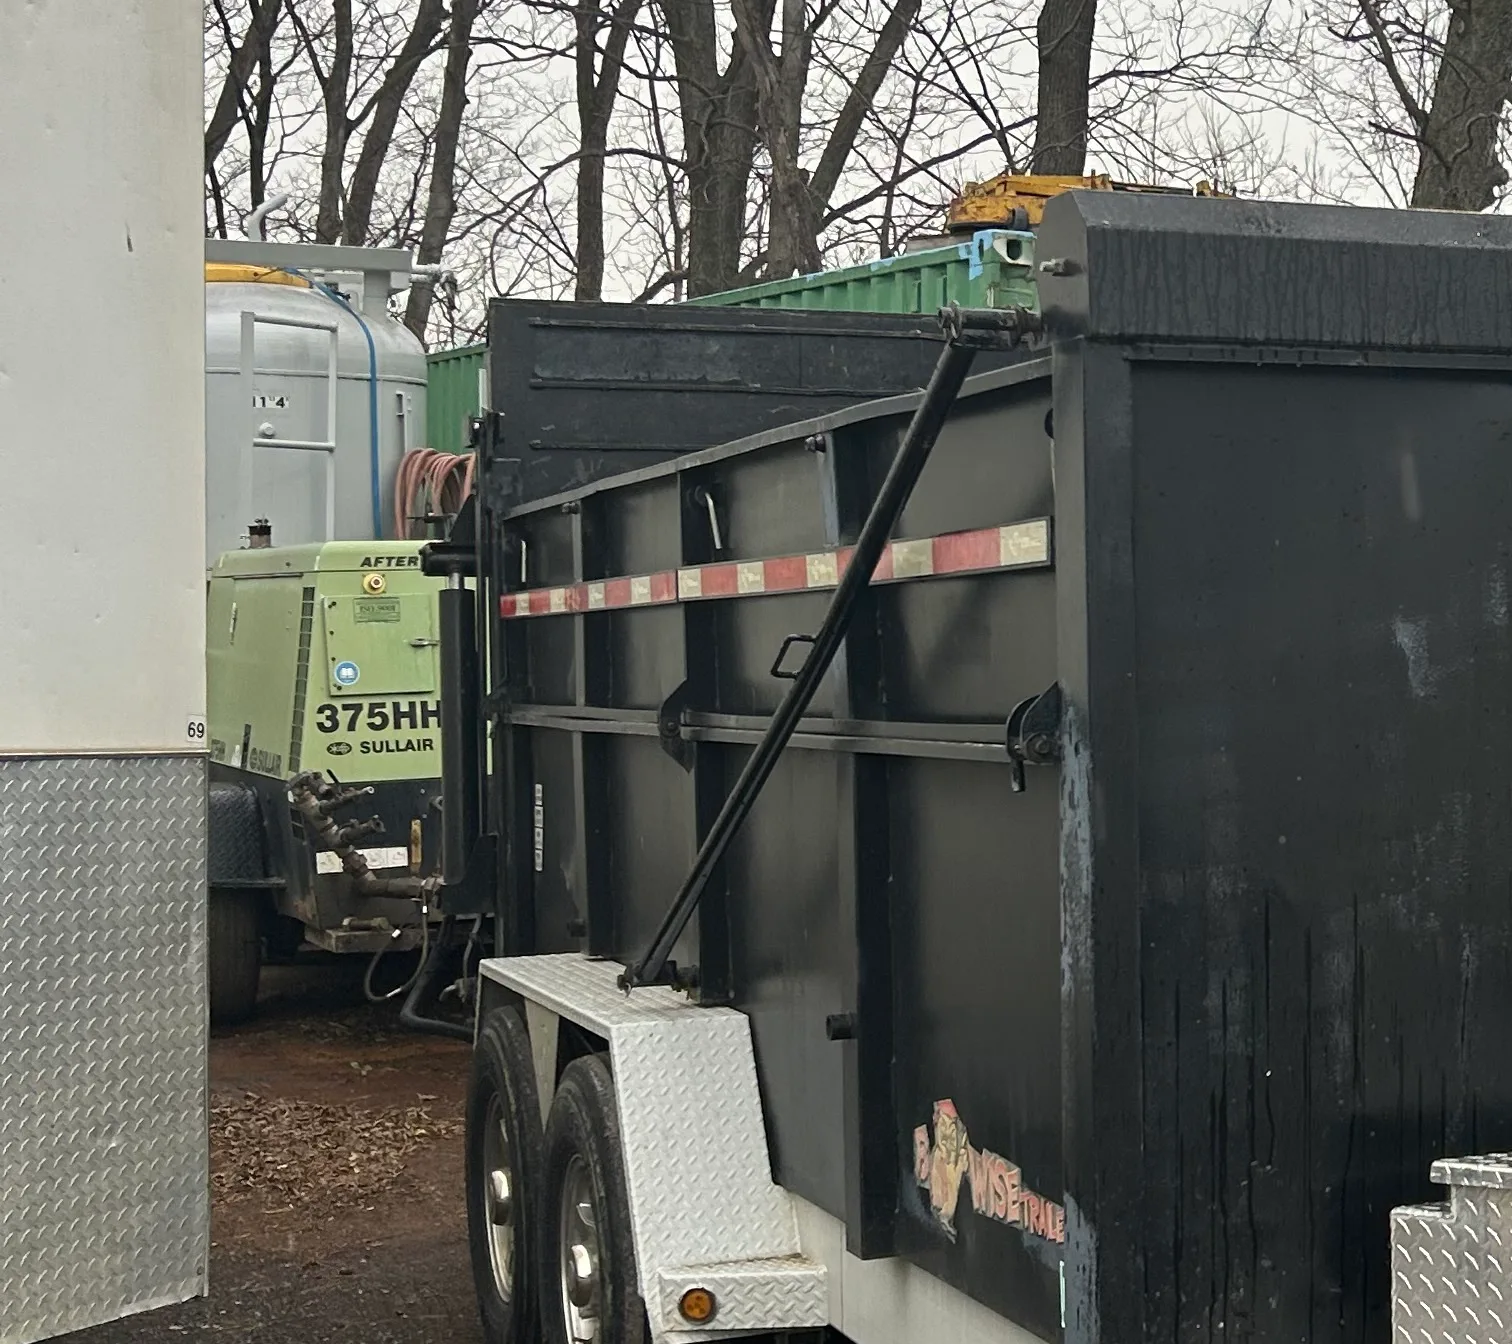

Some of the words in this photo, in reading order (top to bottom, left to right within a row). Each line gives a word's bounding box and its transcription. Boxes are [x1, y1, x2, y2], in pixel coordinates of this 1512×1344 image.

[360, 556, 420, 568] AFTER
[187, 721, 205, 739] 69
[360, 738, 434, 754] SULLAIR
